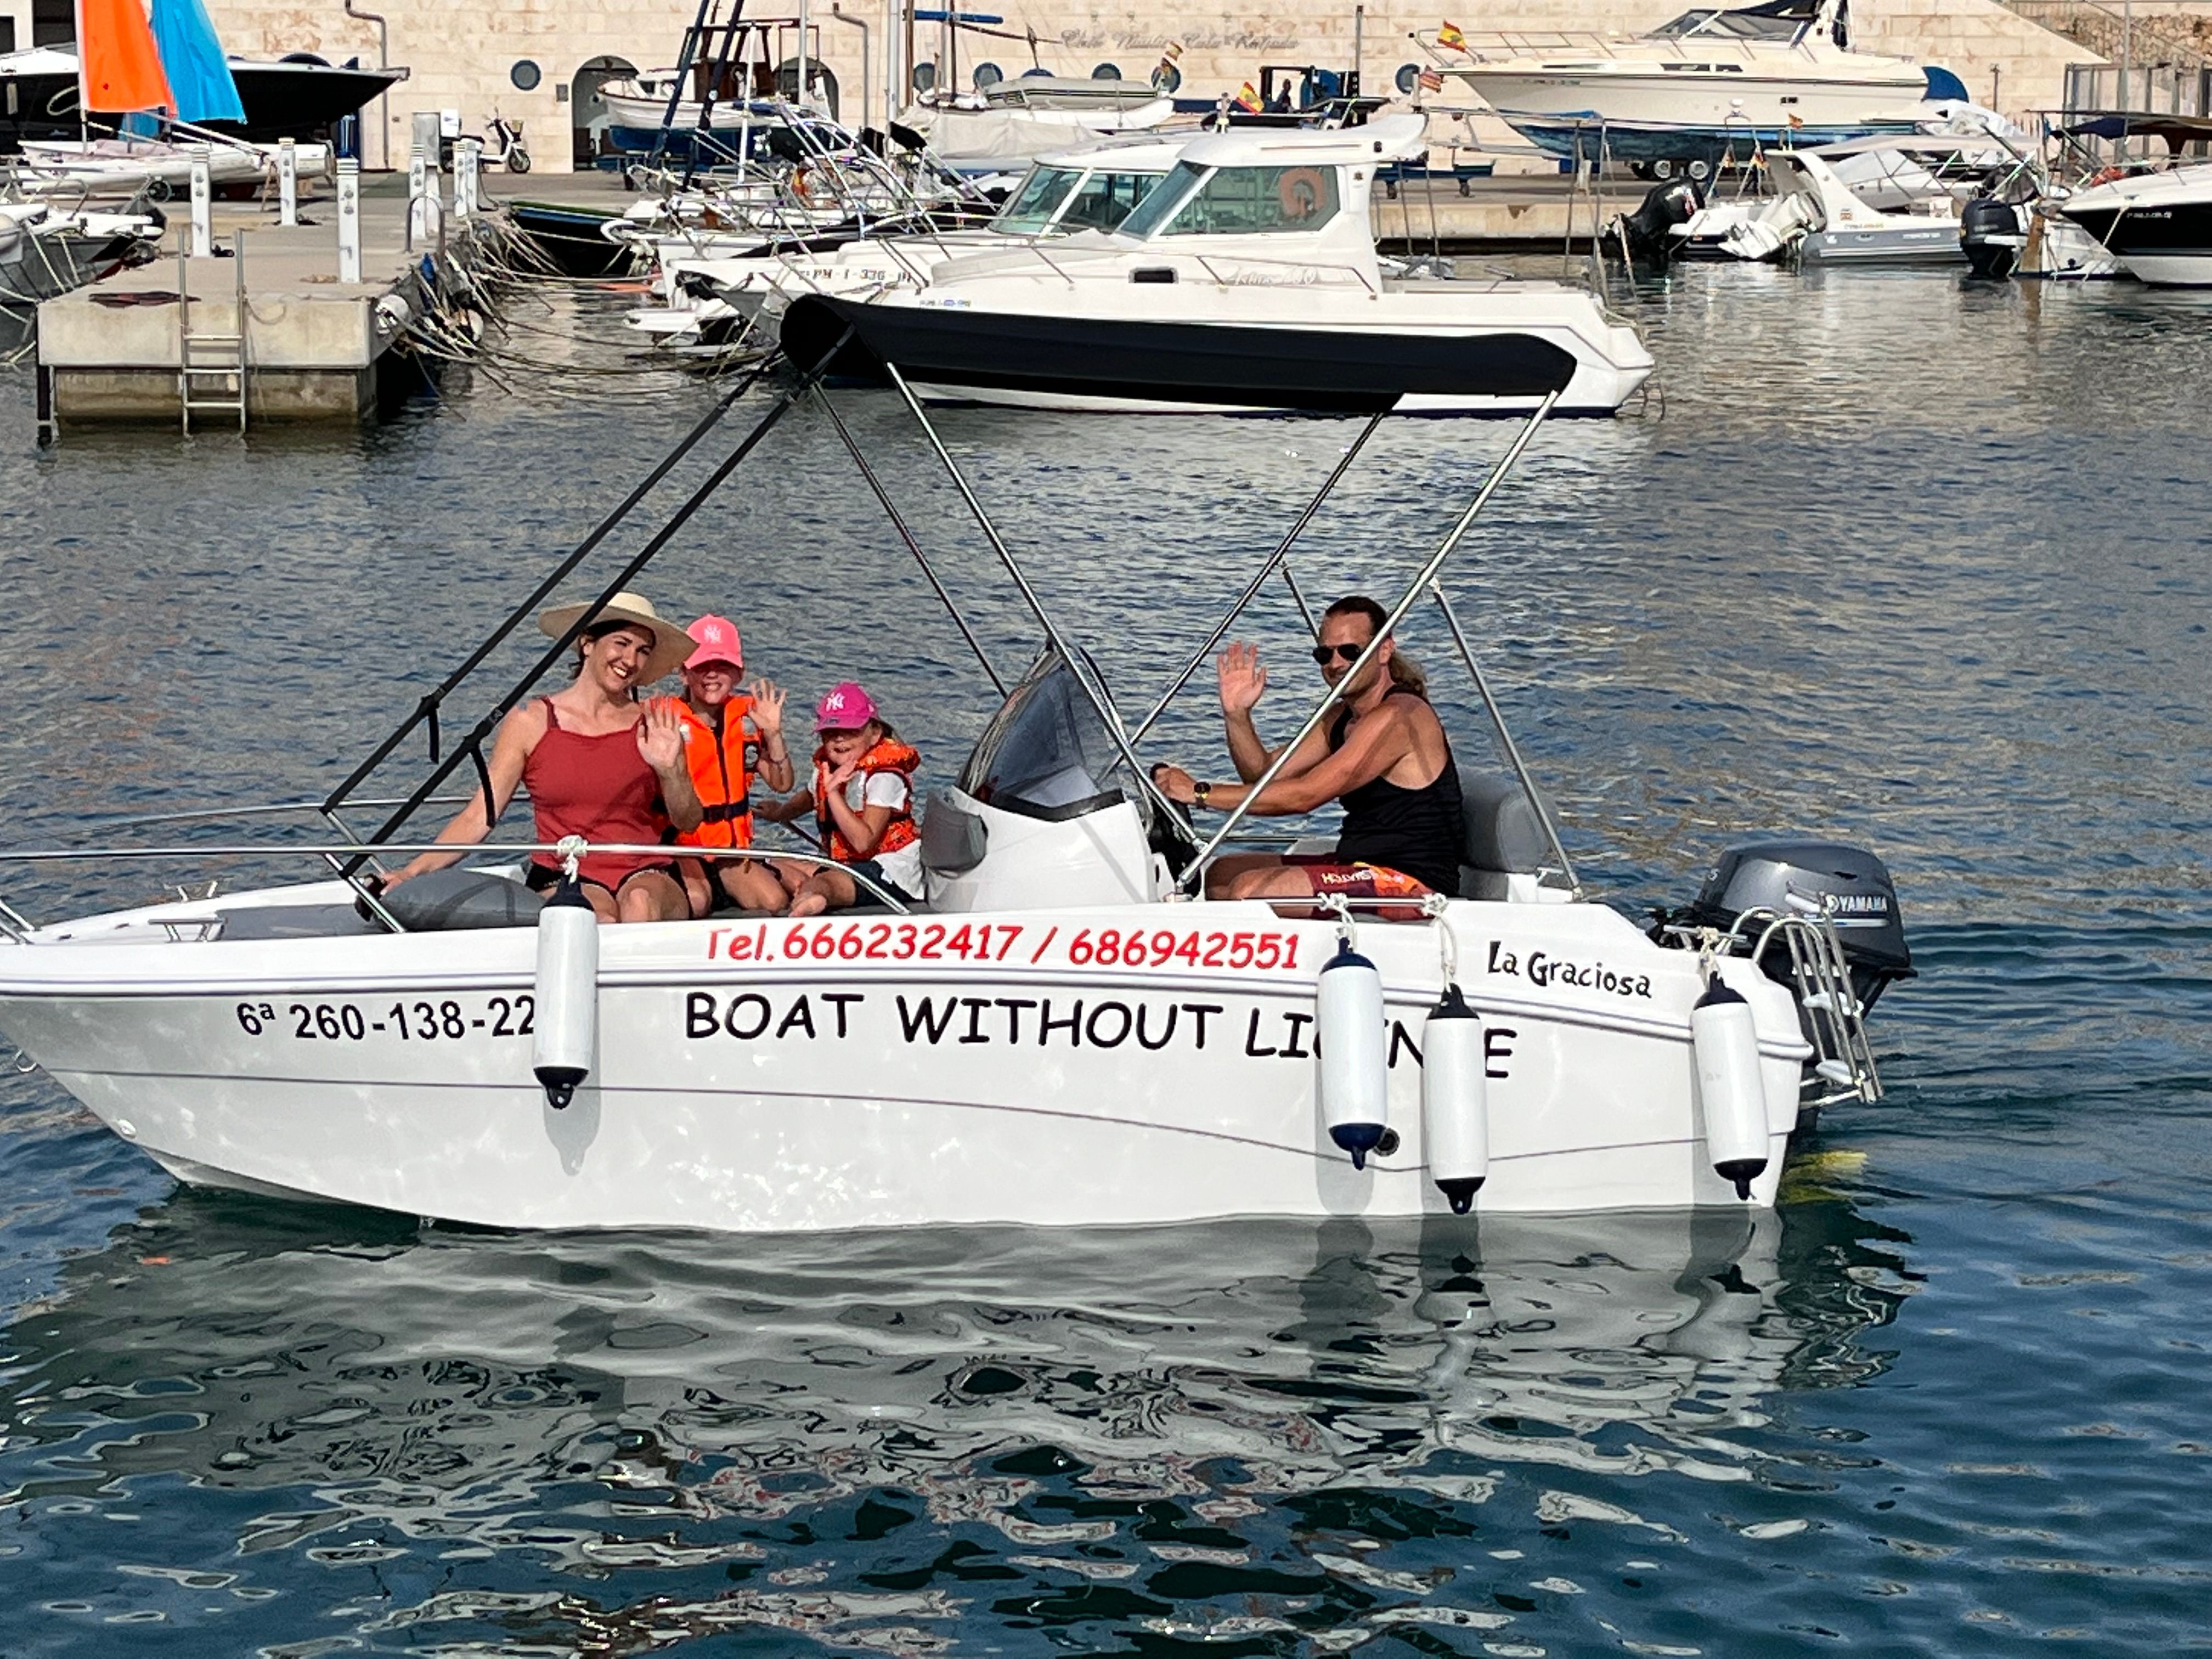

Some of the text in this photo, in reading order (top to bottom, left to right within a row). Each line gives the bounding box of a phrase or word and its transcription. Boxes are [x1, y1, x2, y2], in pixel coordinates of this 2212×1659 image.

[1838, 895, 1888, 912] YAMAHA
[1068, 928, 1299, 969] 686942551
[1488, 940, 1652, 998] La Graciosa
[289, 995, 534, 1040] 260-138-22
[686, 992, 1518, 1079] BOAT WITHOUT LINE
